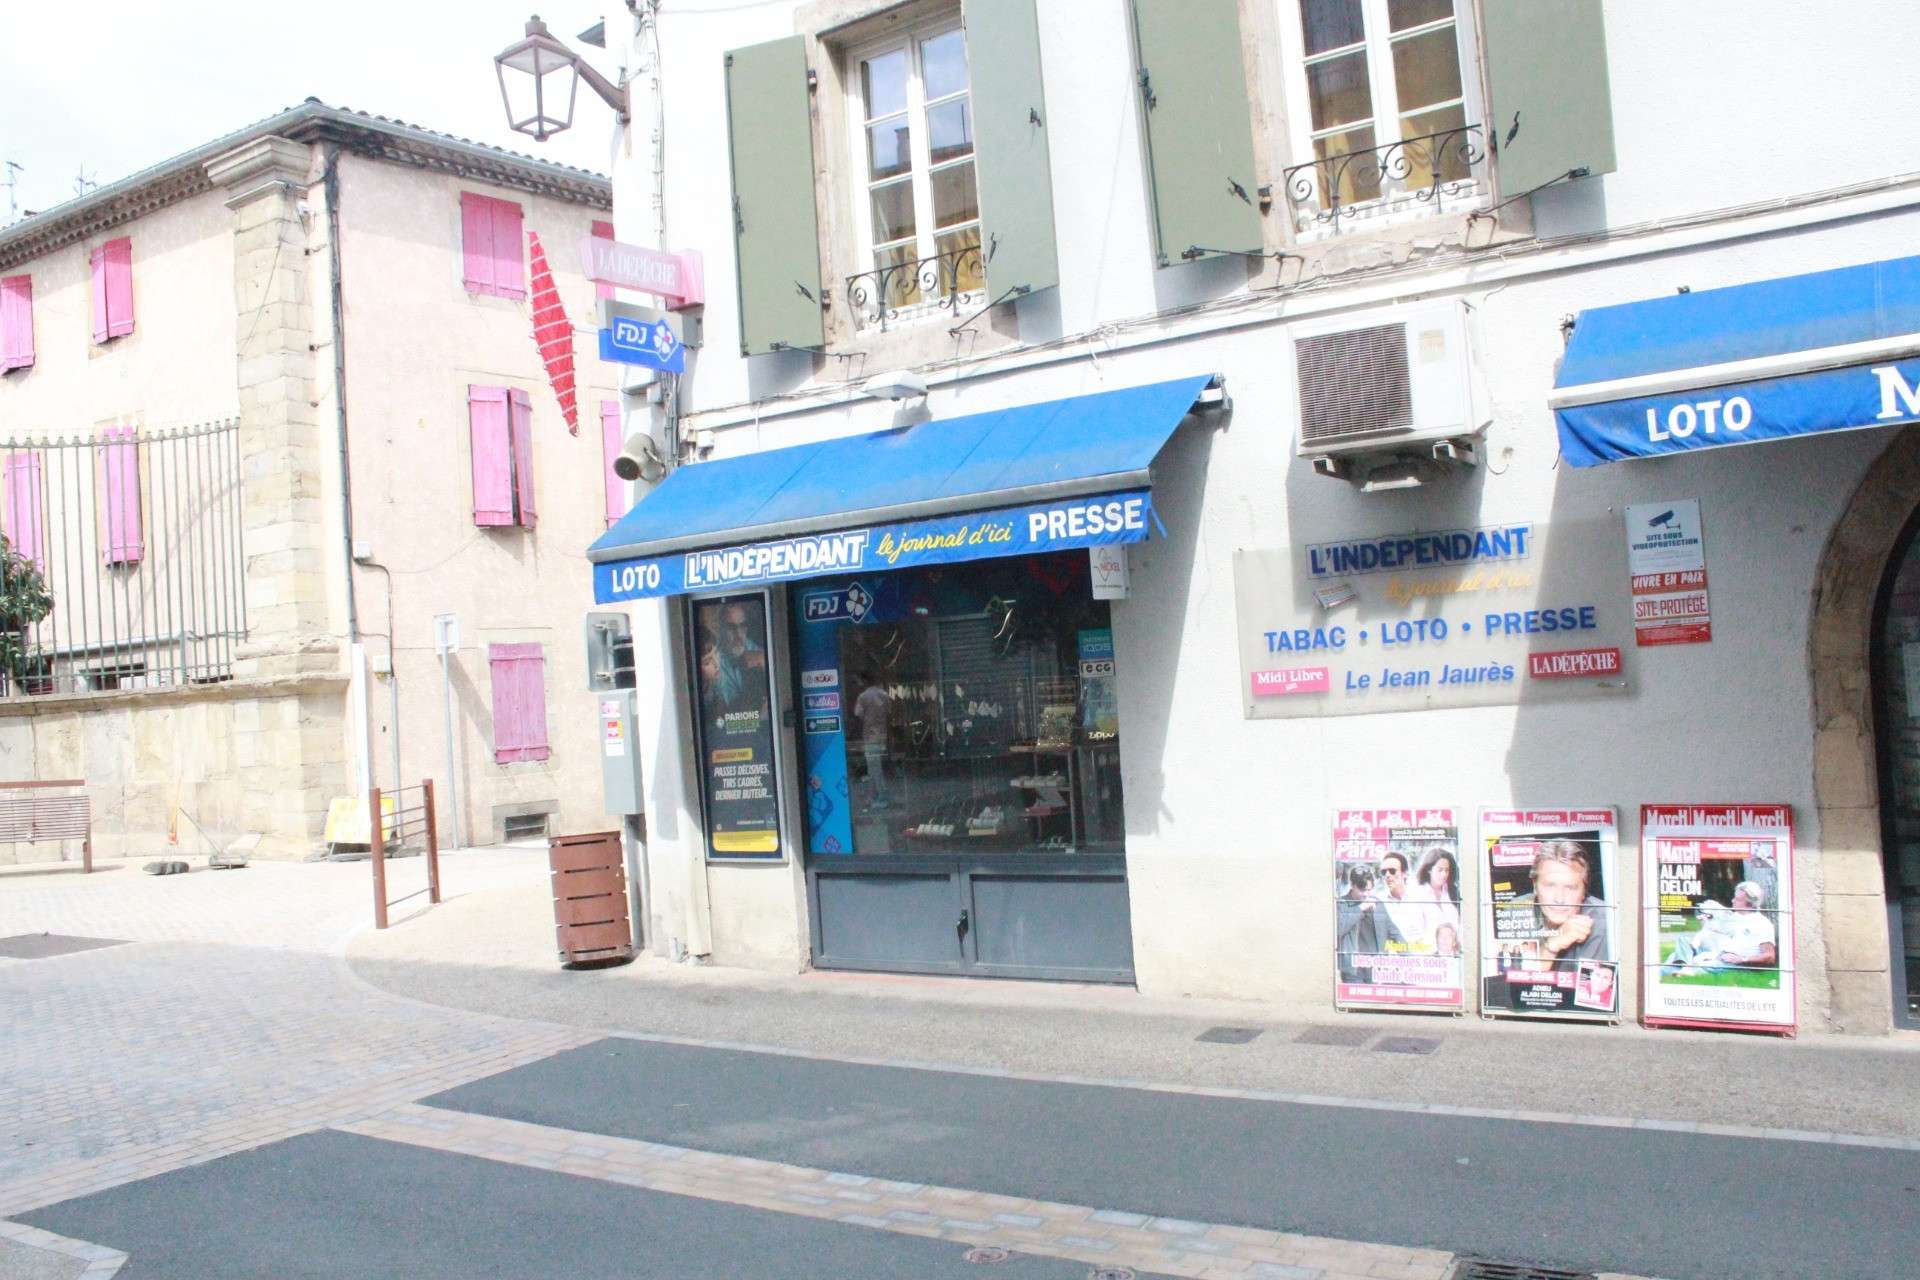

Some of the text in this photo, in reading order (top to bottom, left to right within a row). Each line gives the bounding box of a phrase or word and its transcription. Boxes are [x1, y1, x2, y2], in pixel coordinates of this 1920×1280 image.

[617, 322, 647, 345] FDJ
[1646, 396, 1752, 442] LOTO
[611, 563, 661, 593] LOTO
[876, 532, 894, 556] le
[889, 526, 966, 564] journal
[968, 521, 1013, 544] d'ici
[1028, 498, 1144, 542] PRESSE
[1633, 570, 1705, 589] VIVRE EN PAIX
[808, 596, 840, 616] FDJ
[1635, 594, 1707, 618] SITE PROTÉGÉ
[1263, 605, 1597, 653] TABAC LOTO PRESSE
[1256, 669, 1325, 685] Midi Libre
[1345, 661, 1515, 690] Le Jean Jaurès
[725, 710, 760, 721] PARIONS
[713, 765, 737, 777] PASSES
[723, 777, 737, 789] TIRS
[1660, 863, 1697, 880] ALAIN
[1660, 880, 1702, 895] DELON
[1496, 916, 1536, 930] secret
[1663, 997, 1690, 1008] TOUTES
